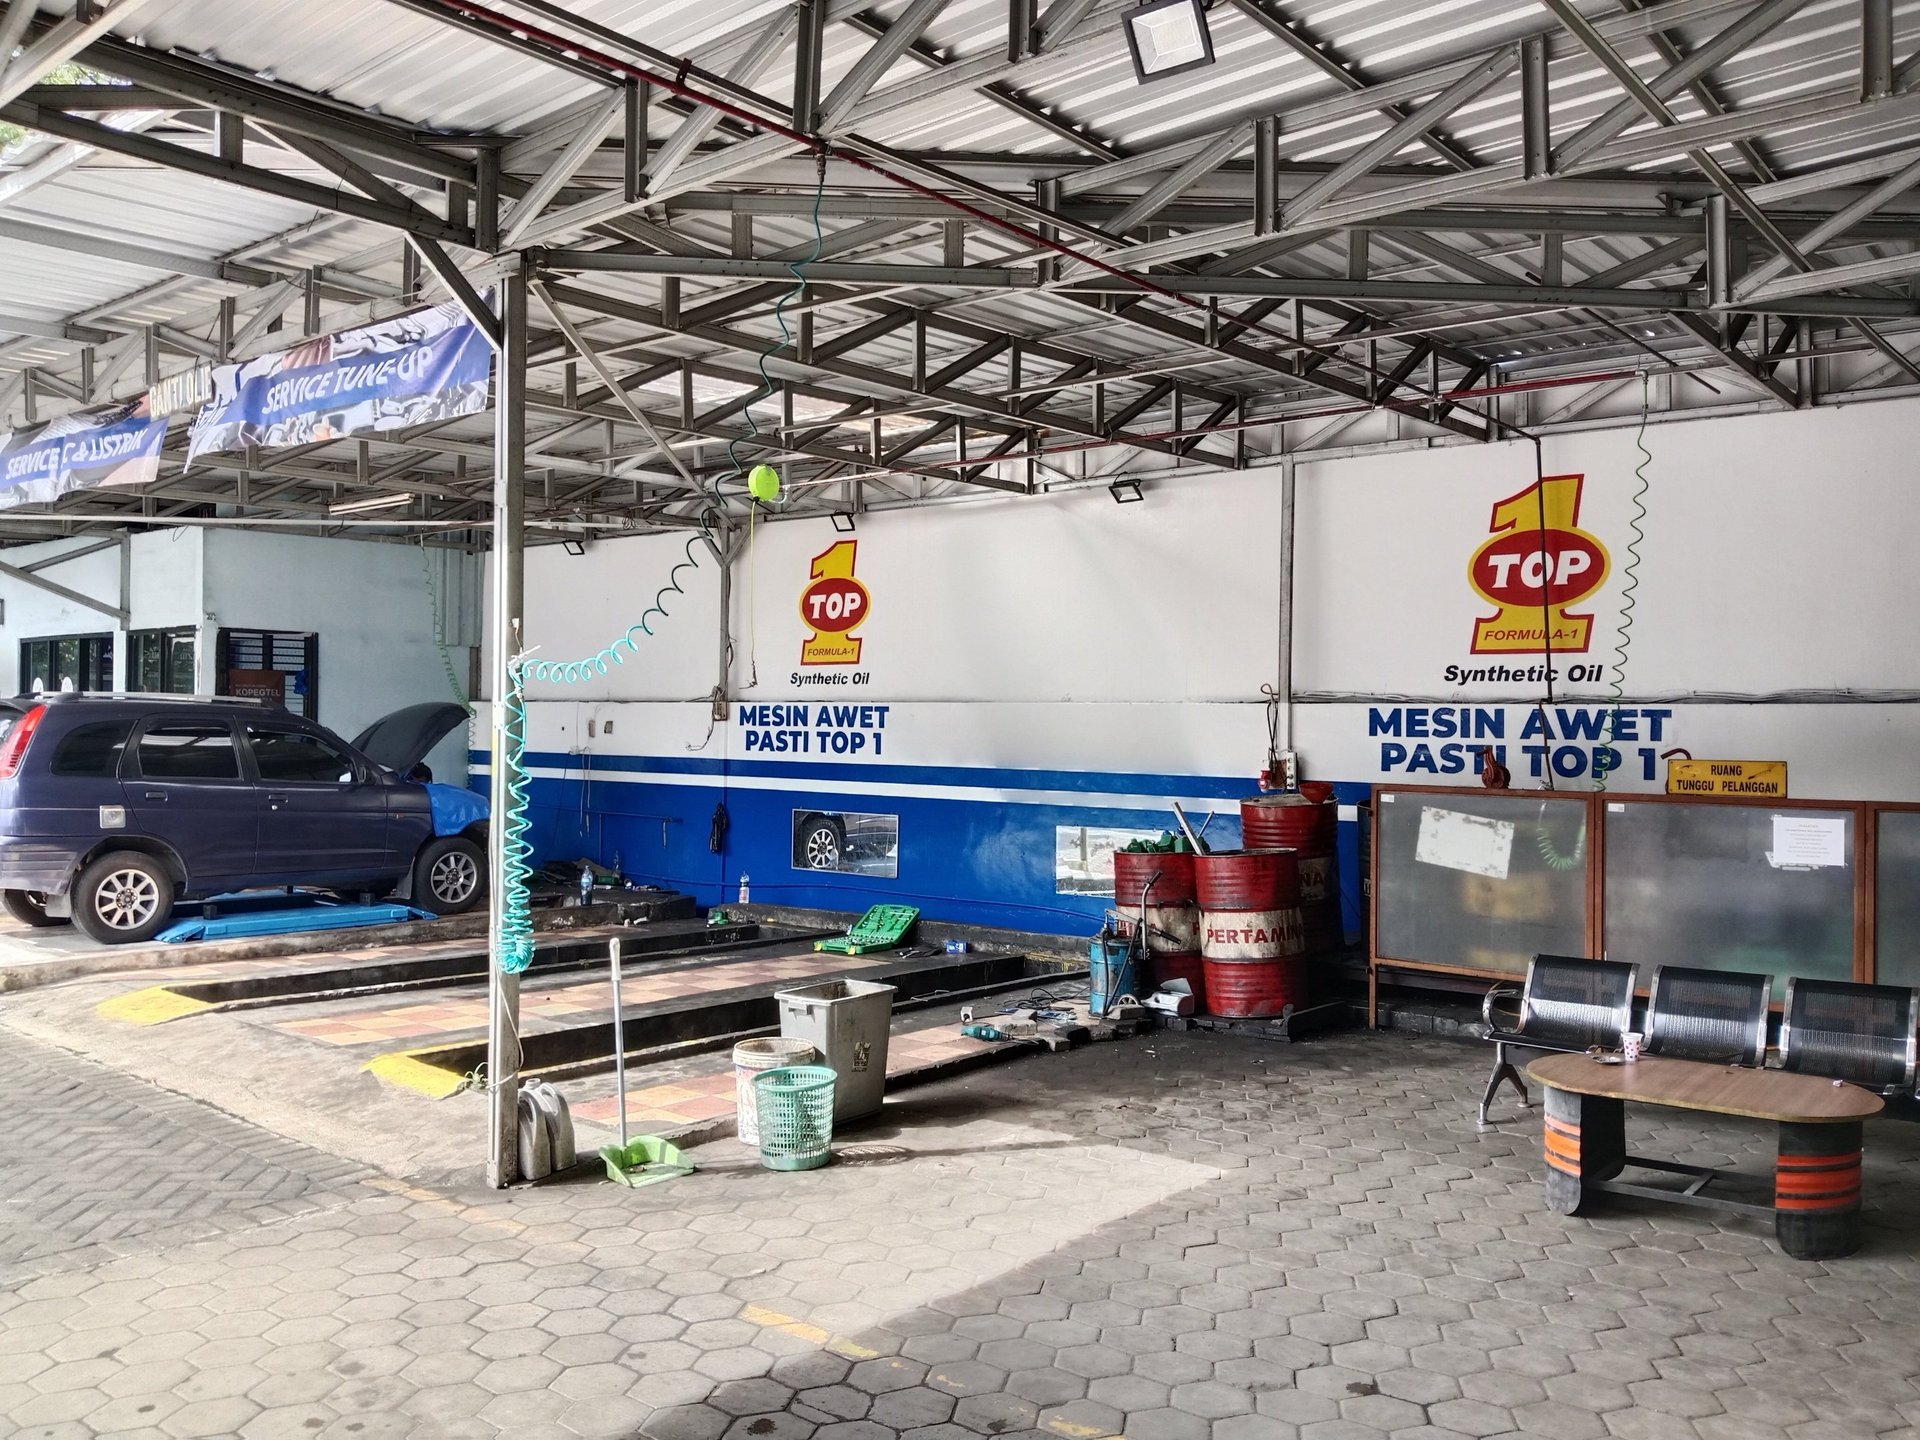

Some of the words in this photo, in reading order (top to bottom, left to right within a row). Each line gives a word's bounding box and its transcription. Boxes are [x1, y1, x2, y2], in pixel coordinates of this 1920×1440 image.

[261, 370, 333, 415] SERVICE
[333, 345, 433, 394] TUNE-UP
[149, 373, 184, 419] GANTI
[5, 447, 61, 480] SERVICE
[89, 428, 149, 462] LISTRIK
[1487, 550, 1592, 589] TOP
[809, 592, 862, 620] TOP
[807, 647, 855, 657] FORMULA-1
[790, 672, 848, 687] Synthetic
[852, 672, 870, 685] Oil
[1443, 664, 1559, 686] Synthetic
[1567, 664, 1603, 683] Oil
[739, 705, 809, 727] MESIN
[815, 706, 890, 729] AWET
[1369, 707, 1505, 739] MESIN
[1519, 708, 1673, 742] AWET
[745, 731, 810, 752] PASTI
[816, 732, 866, 754] TOP
[872, 733, 882, 755] 1
[1380, 742, 1507, 775] PASTI
[1521, 745, 1622, 779] TOP
[1638, 748, 1656, 781] 1
[1710, 765, 1743, 776] RUANG
[1677, 780, 1715, 791] TUNGGU
[1721, 781, 1778, 794] PELANGGAN
